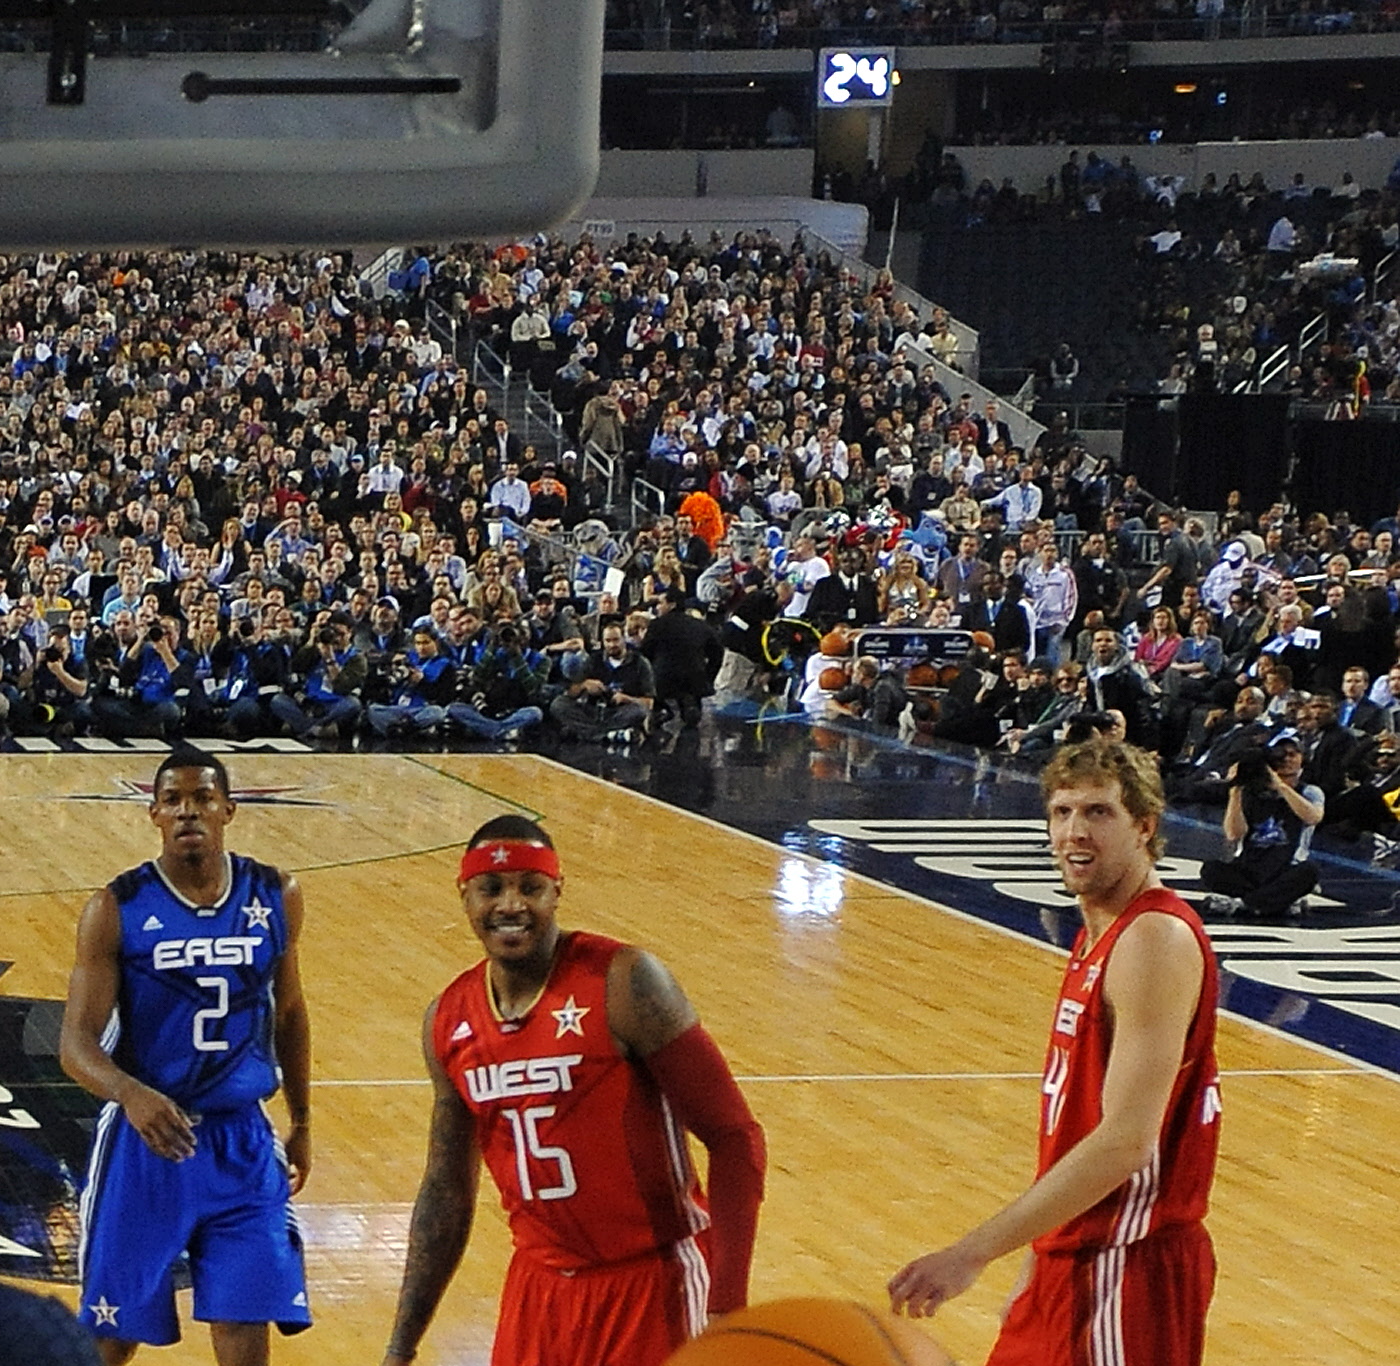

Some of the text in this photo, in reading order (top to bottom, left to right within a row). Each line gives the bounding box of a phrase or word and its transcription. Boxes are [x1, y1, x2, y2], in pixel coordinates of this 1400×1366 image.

[824, 53, 888, 103] 24
[153, 936, 264, 970] EAST
[193, 976, 229, 1051] 2
[463, 1054, 584, 1103] WEST
[502, 1105, 578, 1202] 15
